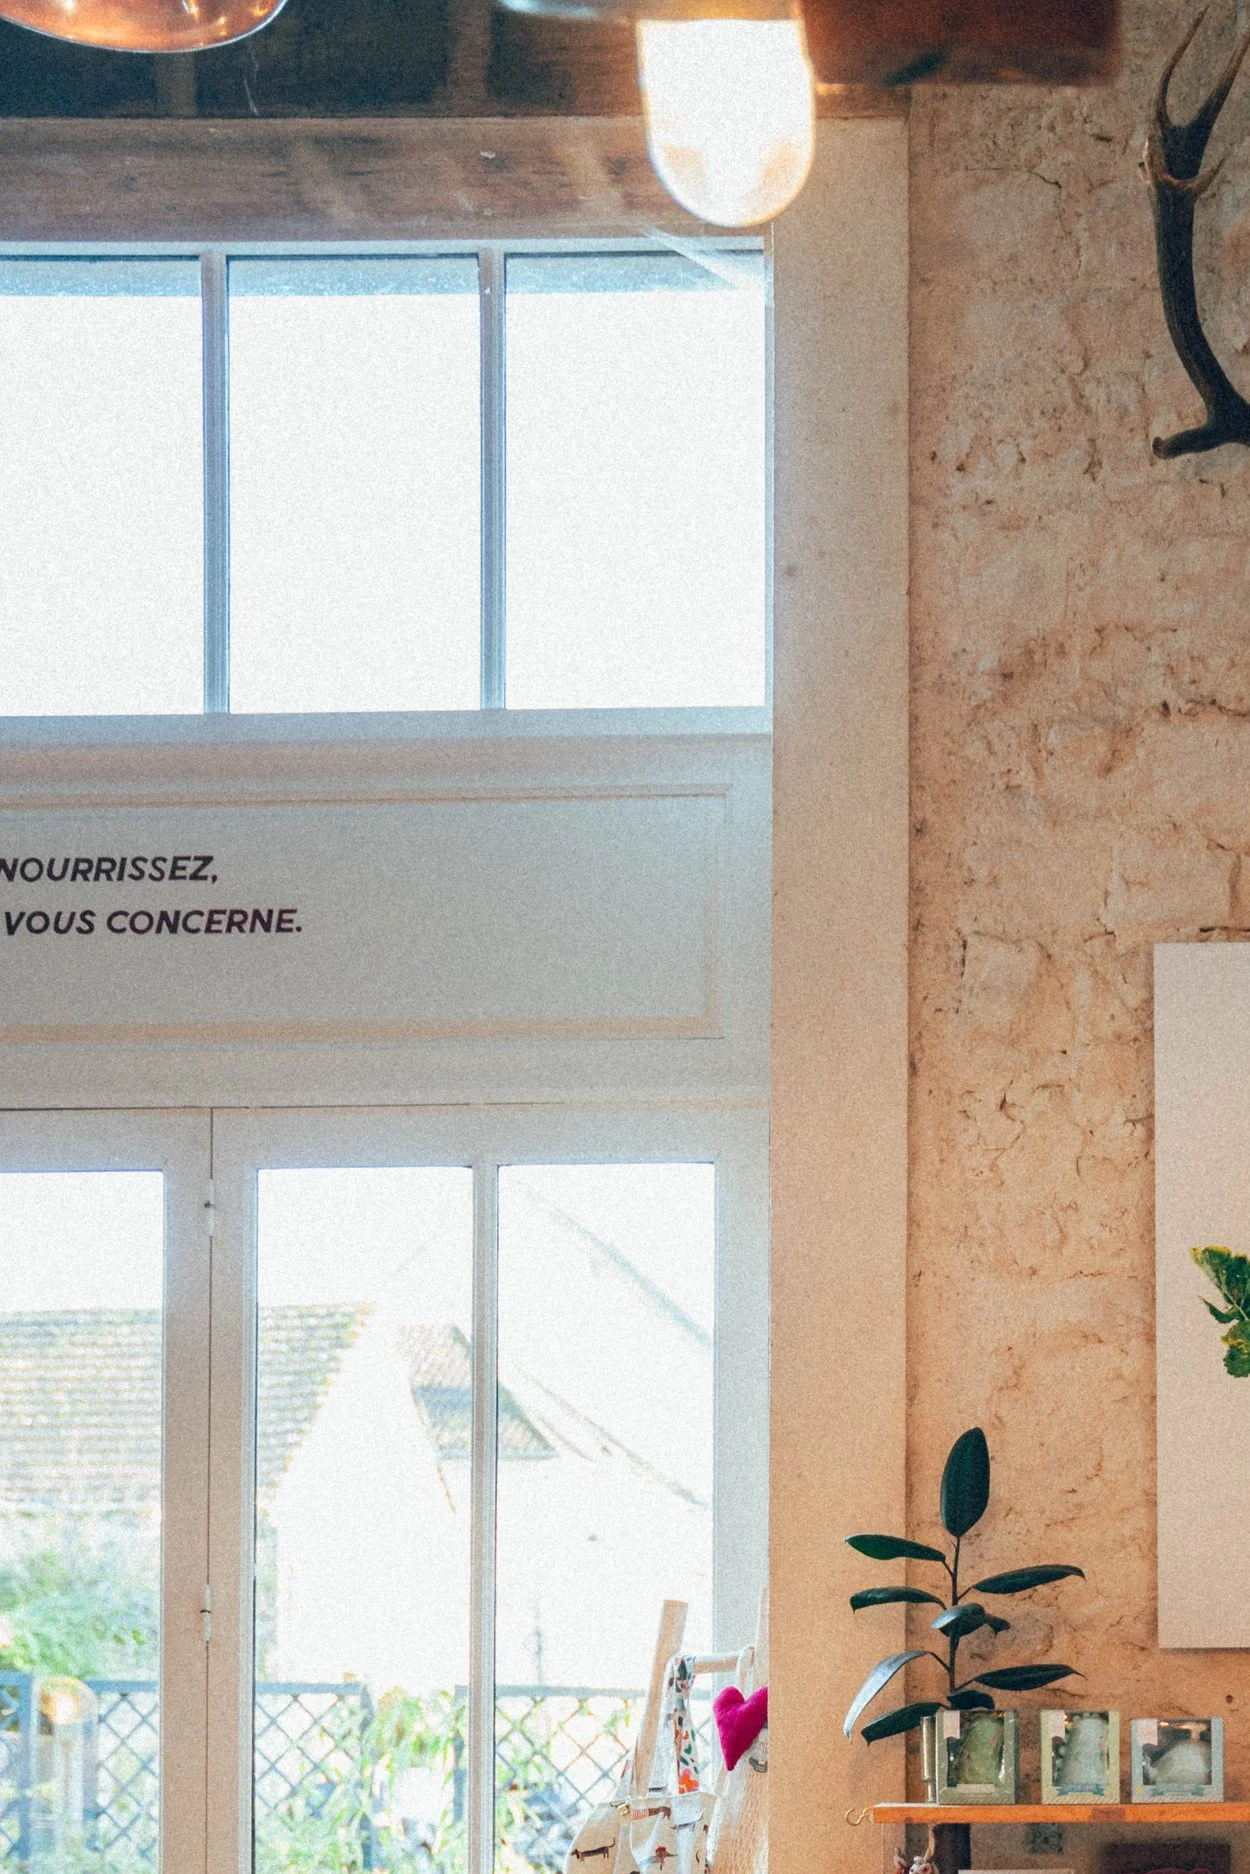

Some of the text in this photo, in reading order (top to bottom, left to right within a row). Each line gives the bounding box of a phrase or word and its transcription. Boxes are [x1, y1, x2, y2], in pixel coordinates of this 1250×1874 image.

[0, 855, 219, 884] NOURRISSEZ,
[4, 908, 303, 936] VOUS CONCERNE.
